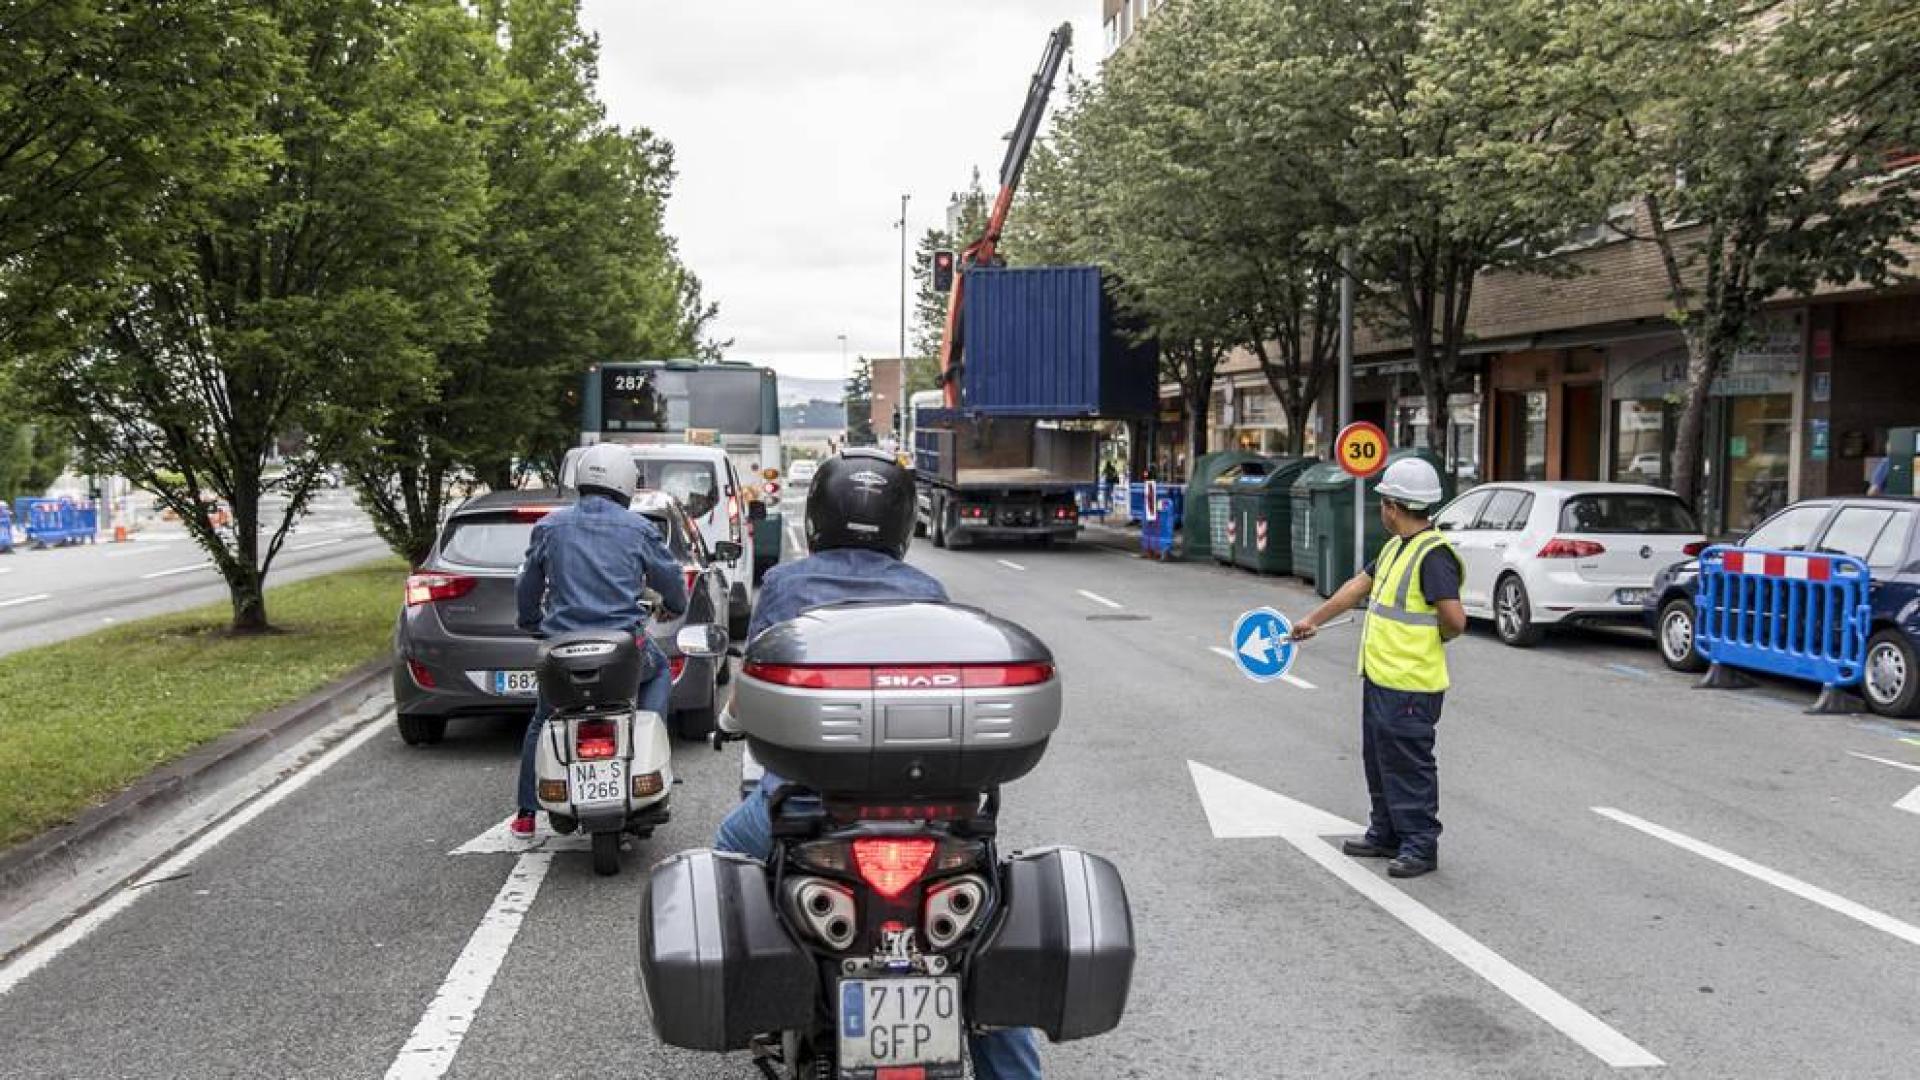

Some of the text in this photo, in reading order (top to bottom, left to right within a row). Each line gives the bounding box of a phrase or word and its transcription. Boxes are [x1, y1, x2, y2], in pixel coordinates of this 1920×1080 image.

[615, 375, 645, 390] 287
[1349, 442, 1375, 459] 30
[877, 674, 958, 687] SHAD
[578, 781, 619, 799] 1266
[870, 985, 953, 1020] 7170
[870, 1023, 931, 1060] GFP
